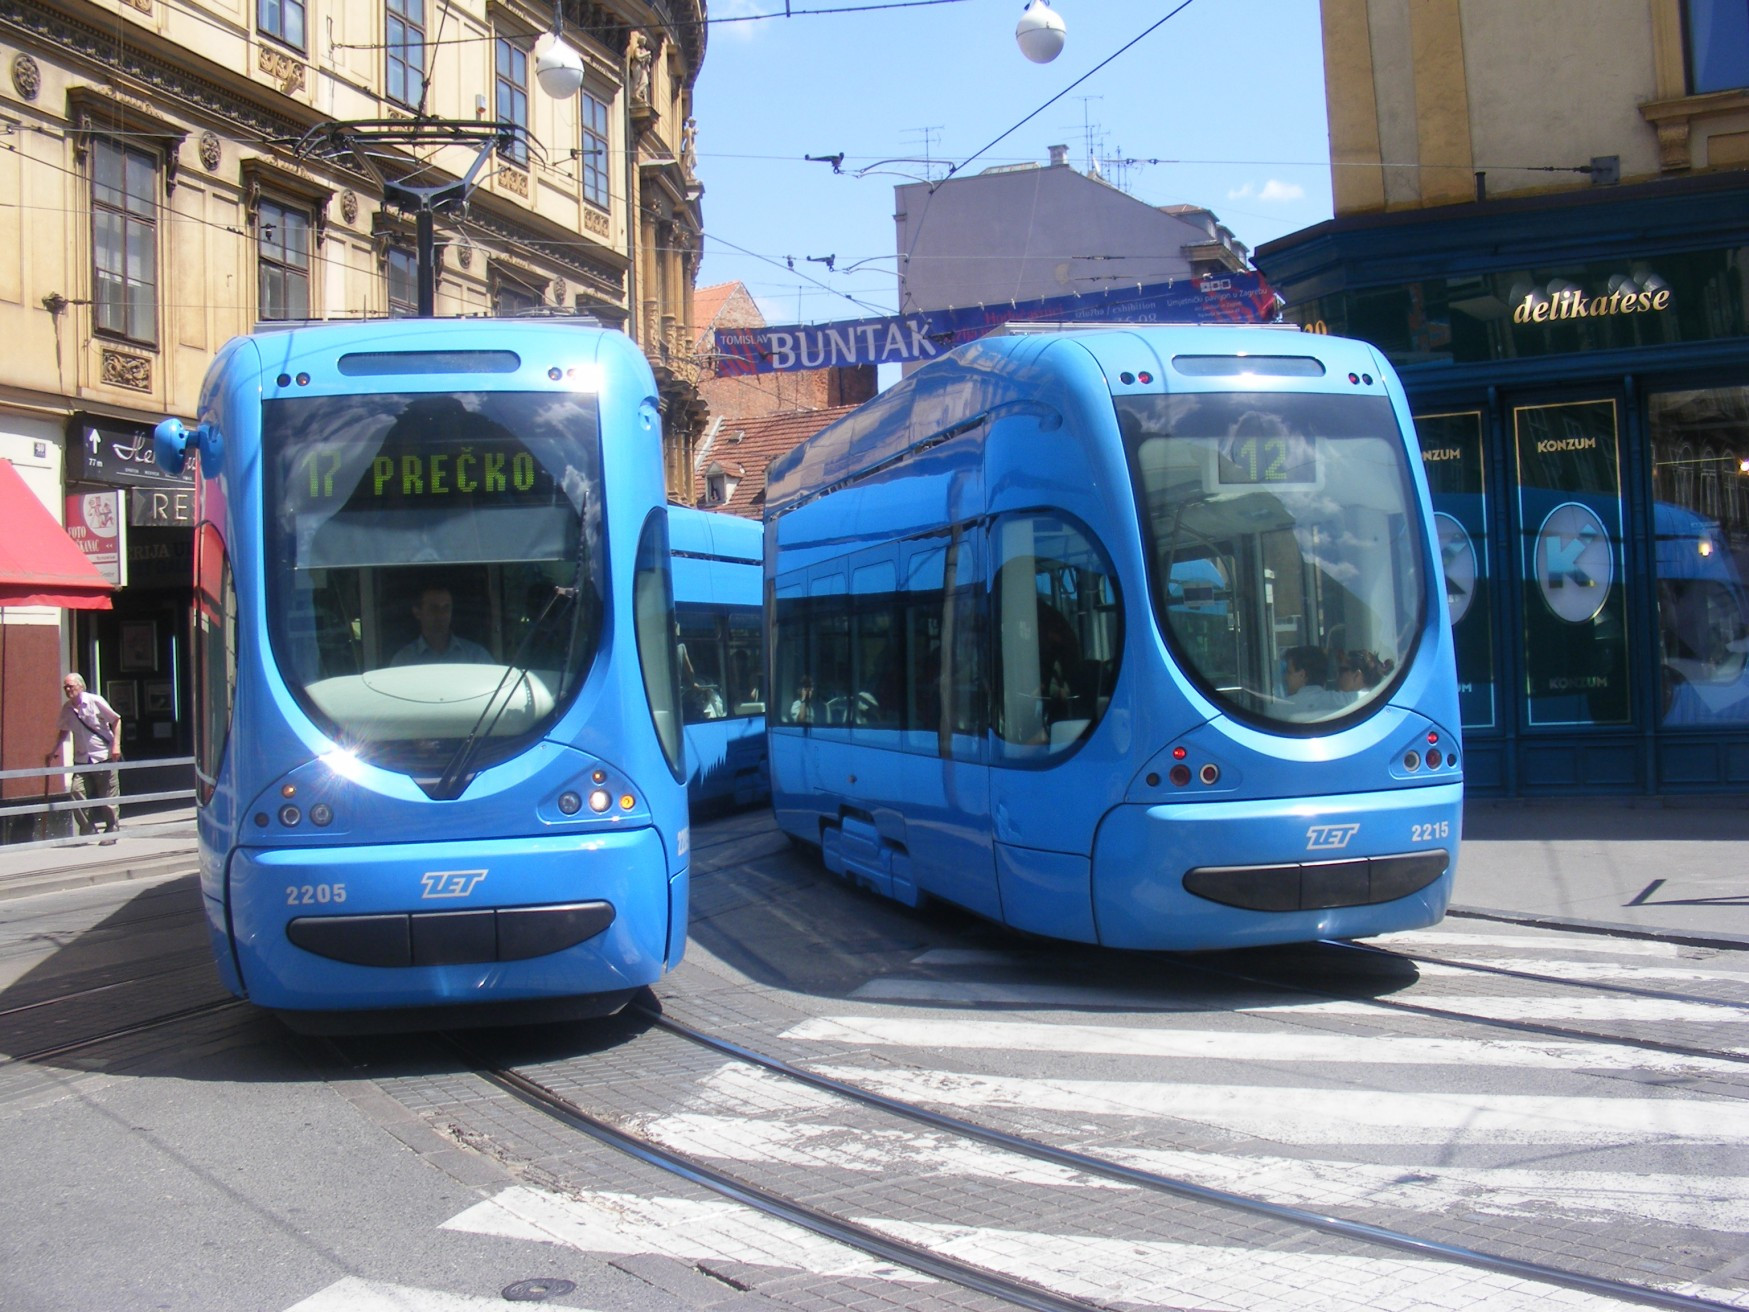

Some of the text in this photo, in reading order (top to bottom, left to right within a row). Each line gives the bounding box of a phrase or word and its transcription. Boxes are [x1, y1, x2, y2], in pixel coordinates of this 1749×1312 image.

[1112, 301, 1156, 314] exhibition
[1513, 288, 1670, 324] delikatese
[720, 334, 769, 346] TOMISLAV
[767, 319, 936, 369] BUNTAK
[1537, 437, 1596, 453] KONZUM
[309, 447, 535, 497] 17 PREČKO
[1240, 439, 1287, 480] 12
[1306, 823, 1361, 850] ZET
[1411, 821, 1450, 842] 2215
[286, 883, 347, 905] 2205
[420, 869, 489, 899] ZET
